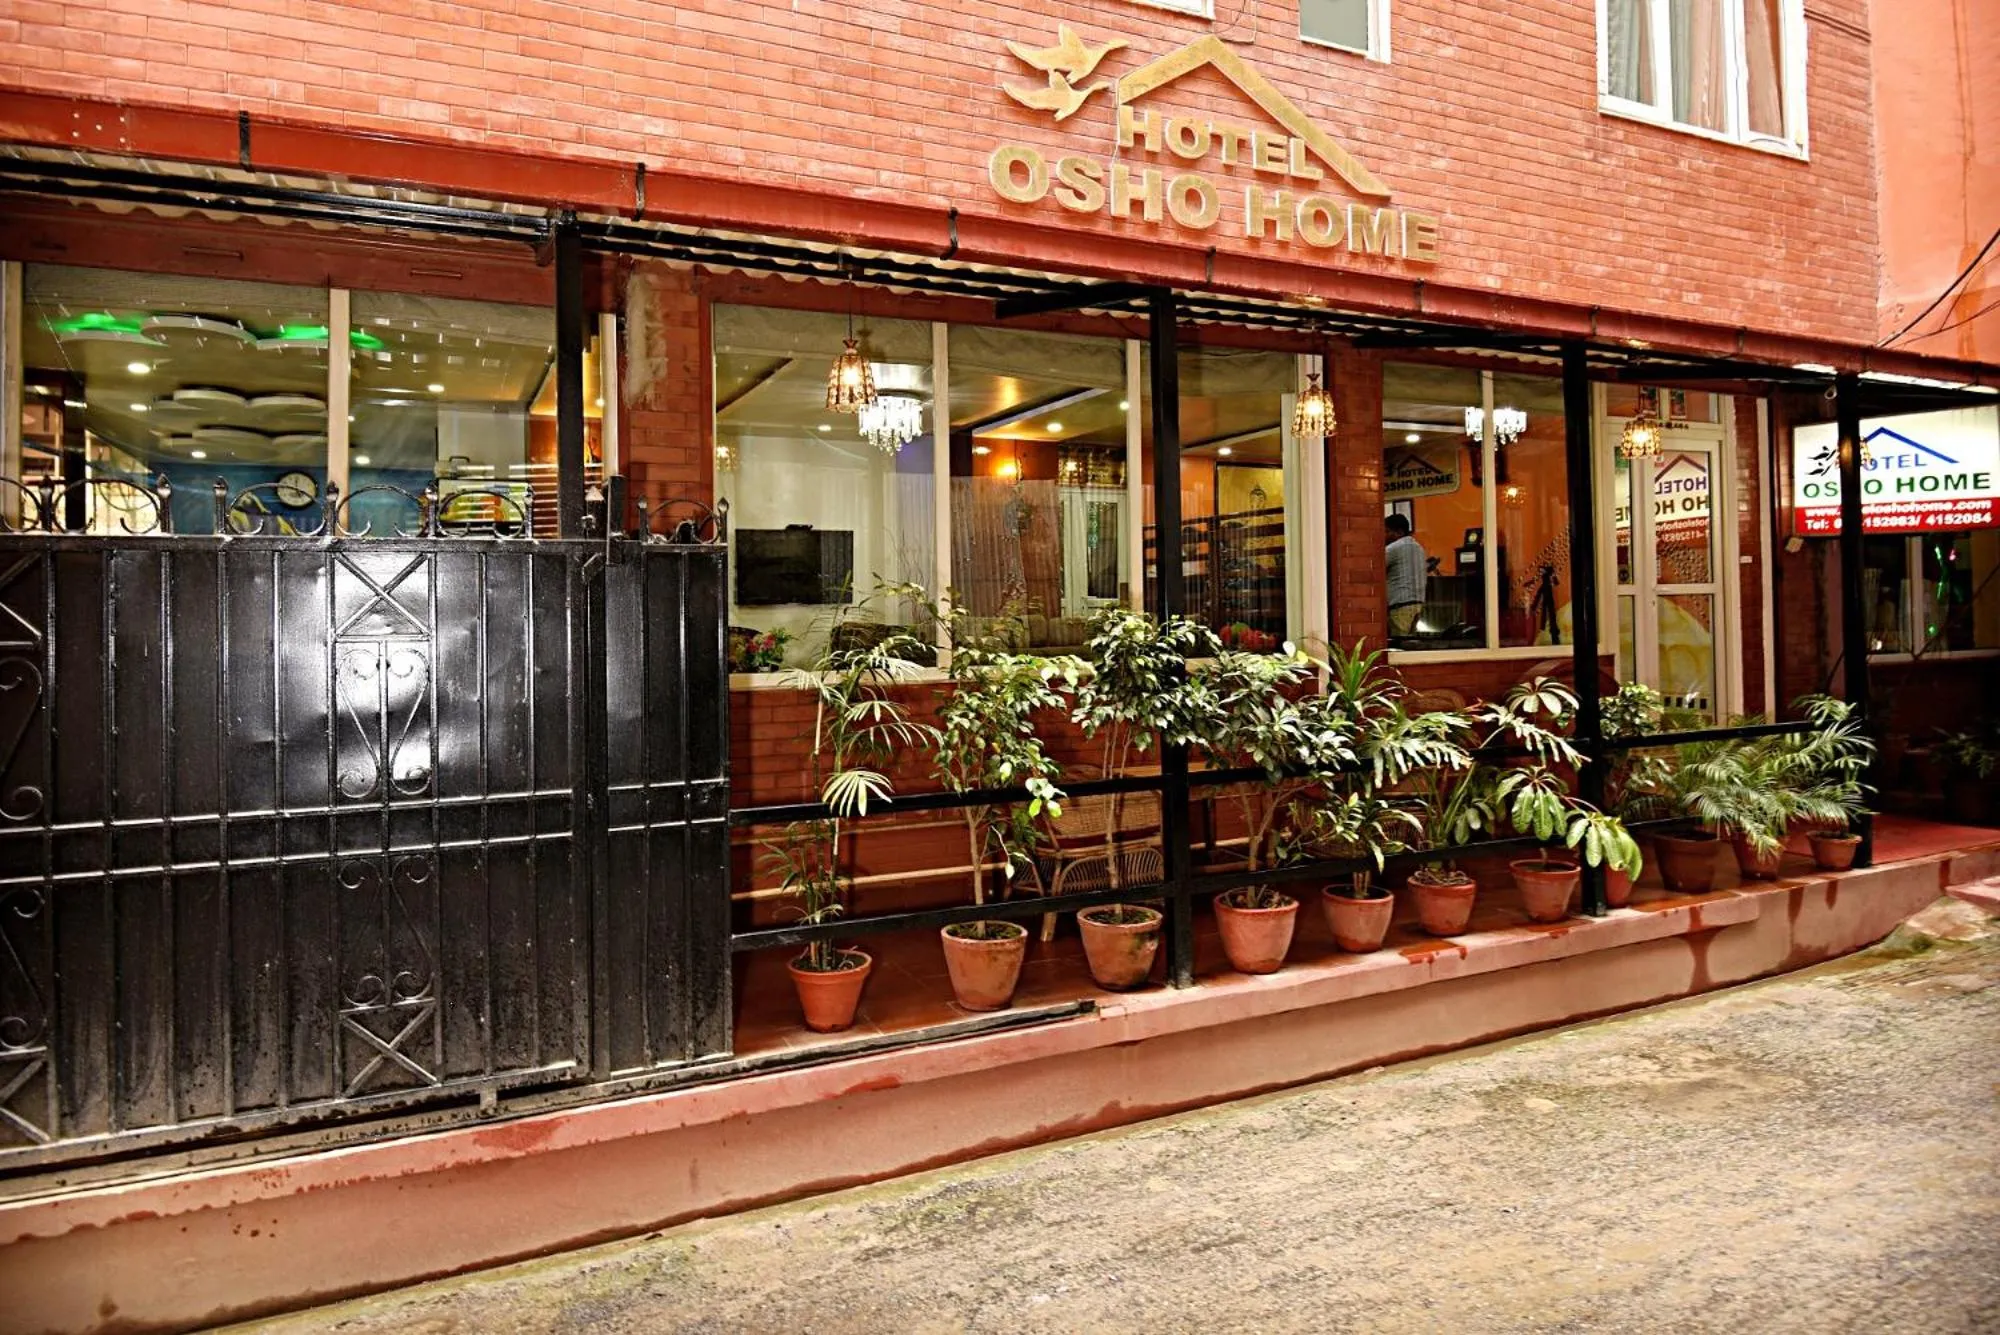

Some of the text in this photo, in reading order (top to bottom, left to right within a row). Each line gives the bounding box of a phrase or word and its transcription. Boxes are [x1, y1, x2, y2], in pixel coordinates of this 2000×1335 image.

[1118, 104, 1324, 181] HOTEL
[988, 144, 1440, 262] OSHO HOME
[1860, 453, 1928, 471] OTEL
[1417, 473, 1454, 488] HOME
[1803, 472, 1992, 498] OSO HOME
[1804, 519, 1830, 531] Tel:
